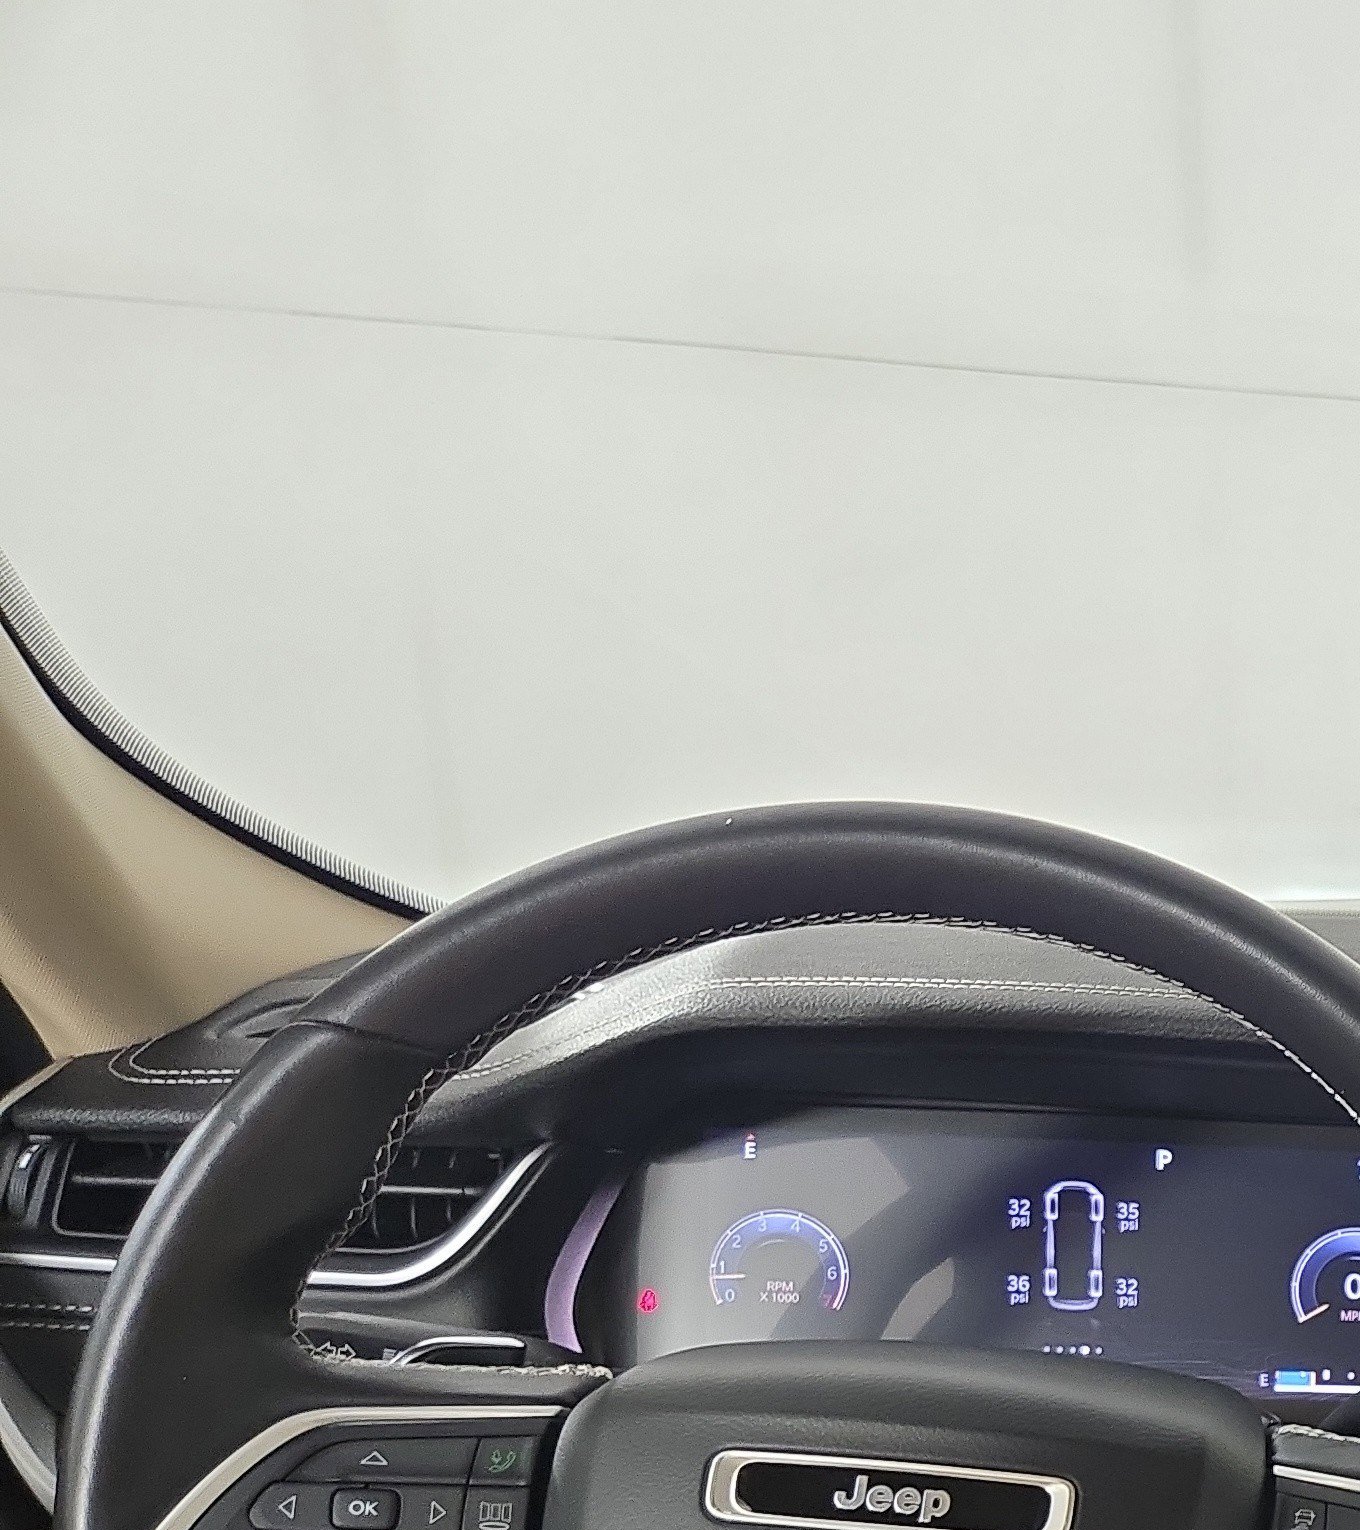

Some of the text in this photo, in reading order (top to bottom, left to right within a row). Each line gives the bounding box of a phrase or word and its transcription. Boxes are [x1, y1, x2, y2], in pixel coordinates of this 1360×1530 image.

[744, 1141, 757, 1159] E
[1155, 1149, 1173, 1171] P
[1008, 1199, 1031, 1215] 32
[1117, 1203, 1140, 1219] 35
[758, 1220, 767, 1232] 3
[791, 1220, 800, 1232] 4
[1011, 1213, 1030, 1229] psi
[1120, 1218, 1139, 1232] psi
[732, 1235, 742, 1248] 2
[819, 1240, 829, 1253] 5
[827, 1266, 837, 1281] 6
[767, 1281, 793, 1291] RPM
[1007, 1275, 1030, 1292] 36
[1116, 1278, 1138, 1295] 32
[725, 1288, 735, 1302] 0
[771, 1291, 799, 1303] 1000
[1010, 1291, 1029, 1305] psi
[1118, 1293, 1138, 1308] psi
[1259, 1373, 1270, 1387] E
[833, 1474, 951, 1523] Jeep
[348, 1500, 379, 1517] OK
